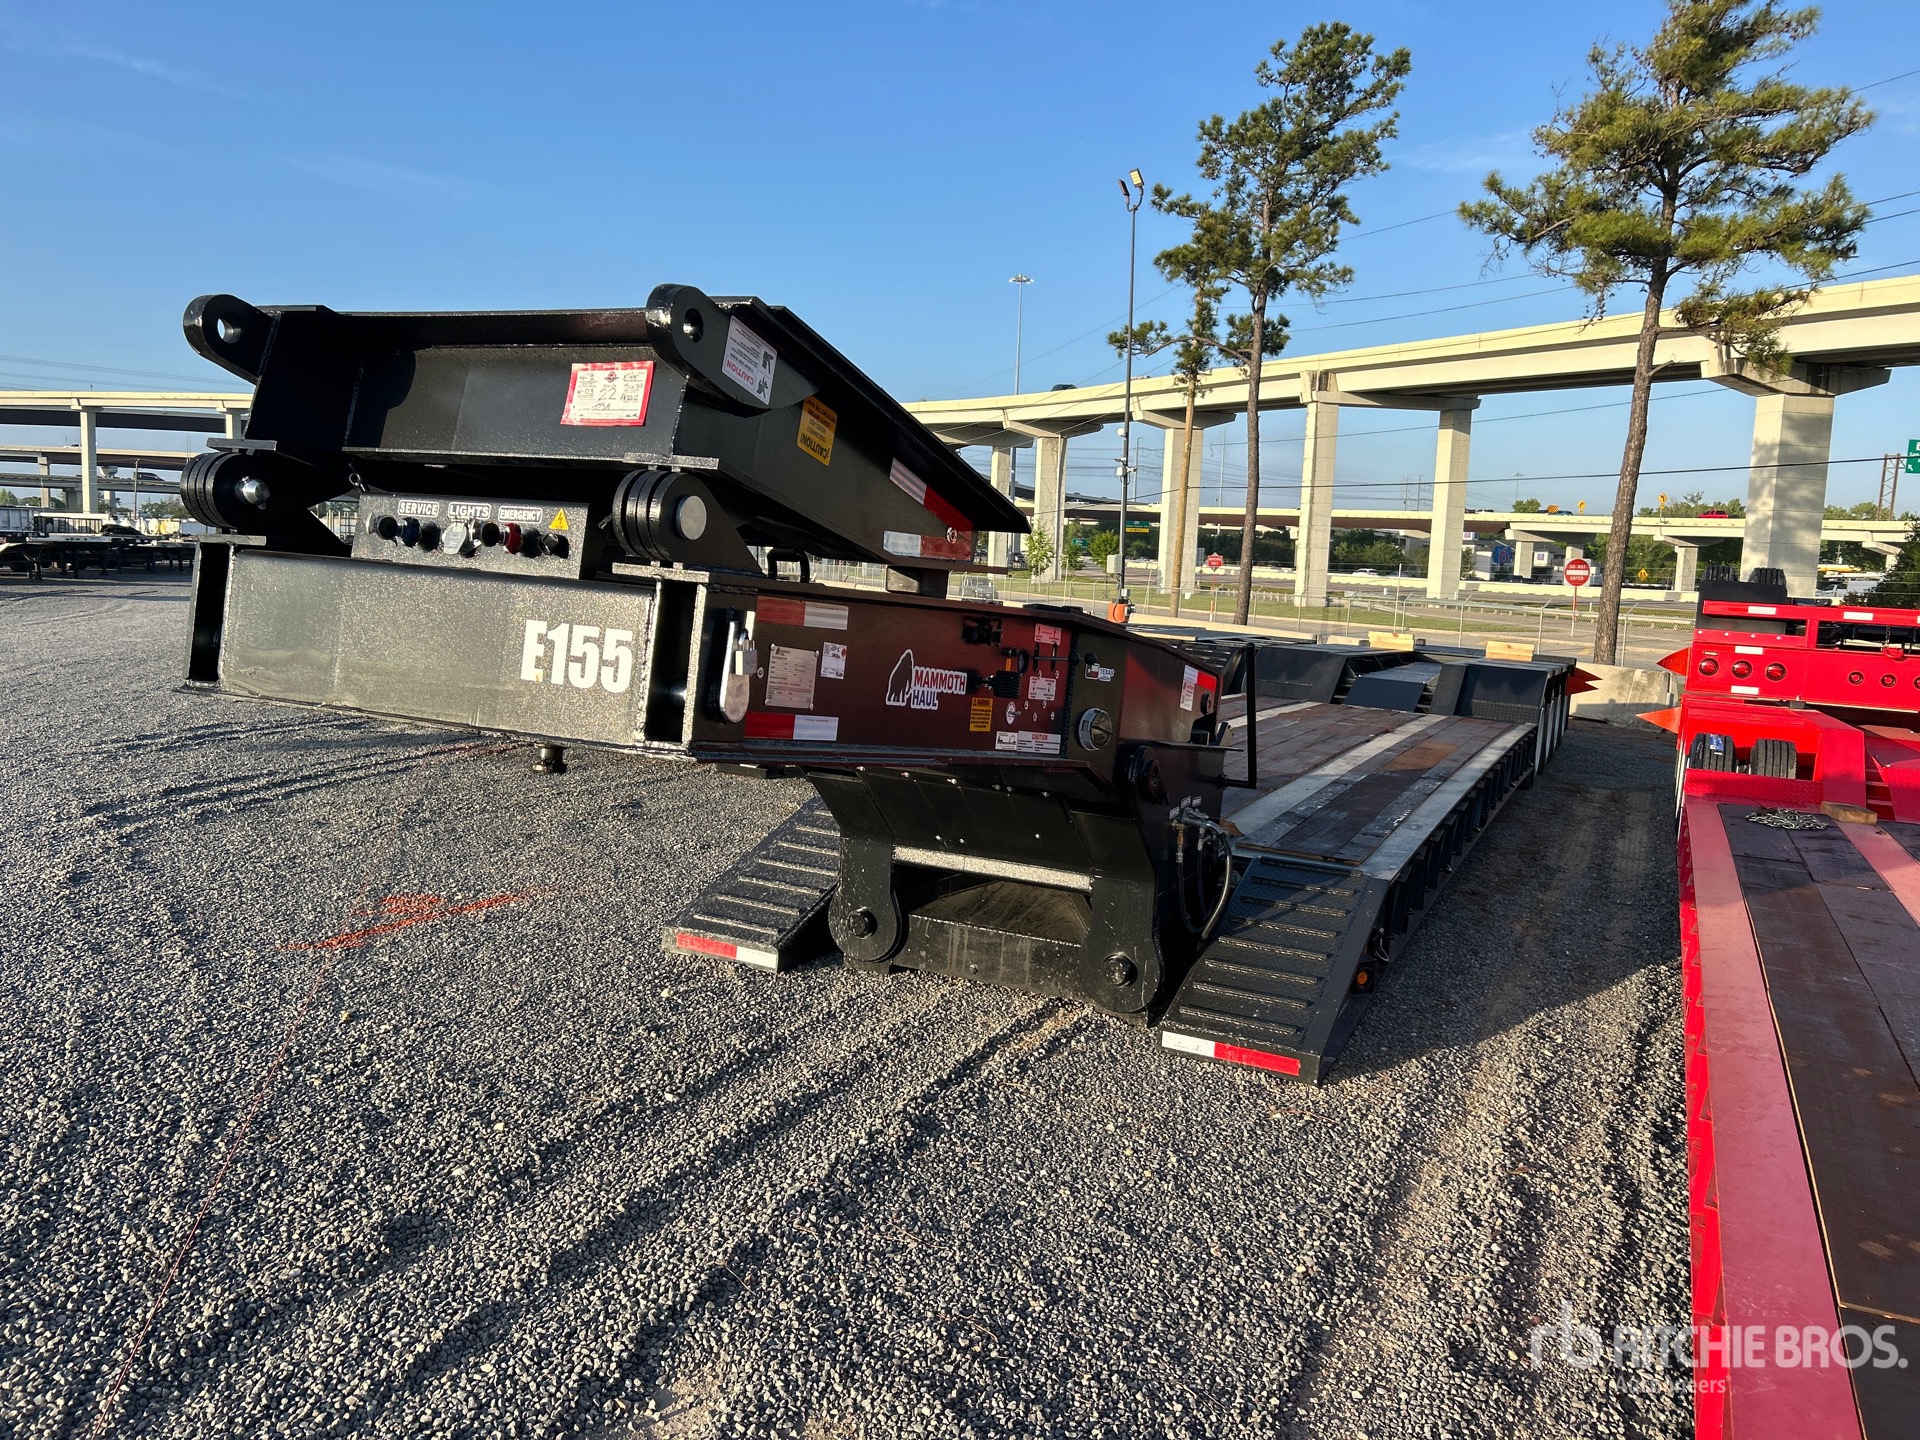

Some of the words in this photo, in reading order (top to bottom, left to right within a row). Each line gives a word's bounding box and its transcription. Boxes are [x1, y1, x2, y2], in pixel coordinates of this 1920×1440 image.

[726, 360, 754, 386] CAUTION
[598, 388, 616, 401] 22
[400, 502, 438, 516] SERVICE
[450, 504, 490, 518] LIGHTS
[500, 510, 542, 521] EMERGENCY
[1499, 547, 1510, 563] 6
[520, 619, 633, 694] E155
[914, 670, 966, 692] MAMMOTH
[912, 688, 937, 707] HAUL
